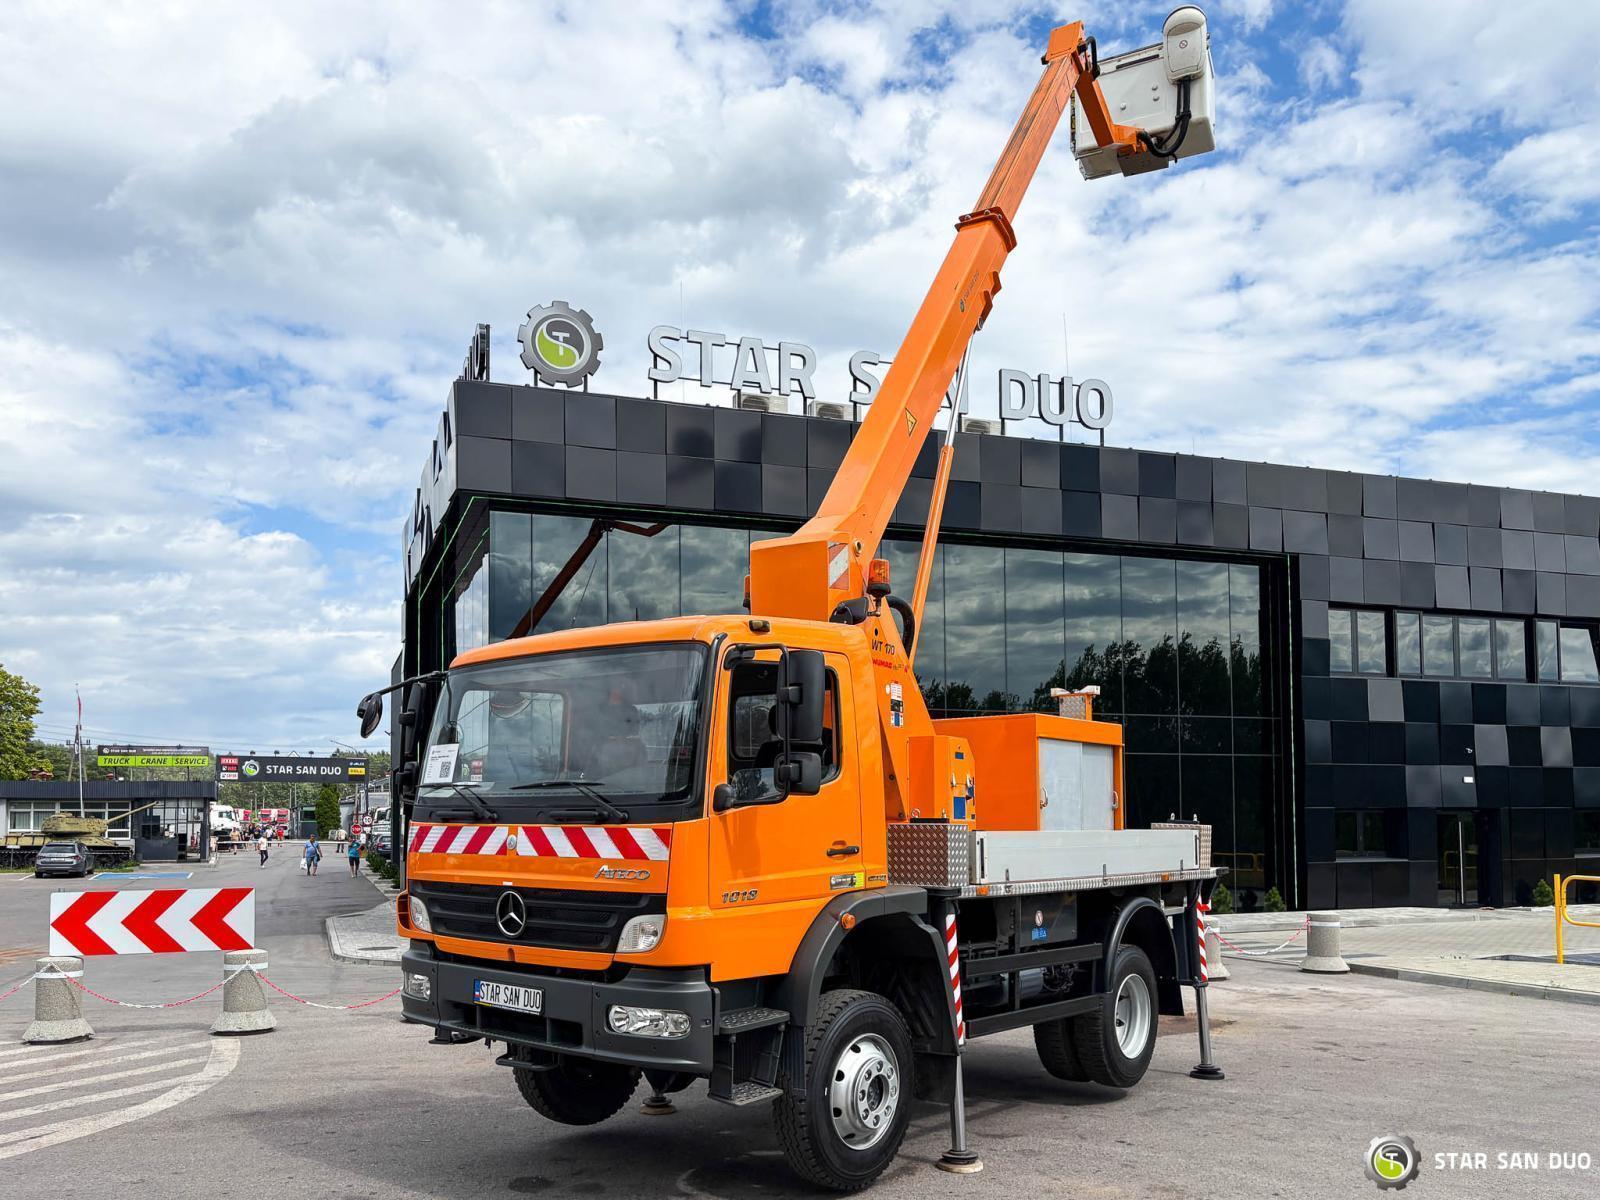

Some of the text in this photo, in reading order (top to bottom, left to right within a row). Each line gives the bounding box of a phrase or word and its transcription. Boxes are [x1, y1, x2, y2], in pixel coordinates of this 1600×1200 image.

[648, 325, 817, 399] STAR
[999, 368, 1114, 430] DUO
[872, 639, 883, 652] WT
[103, 757, 207, 765] TRUCK CRANE SERVICE
[266, 765, 293, 774] STAR
[296, 766, 317, 775] SAN
[320, 766, 341, 775] DUO
[480, 983, 541, 1009] STAR SAN DUO
